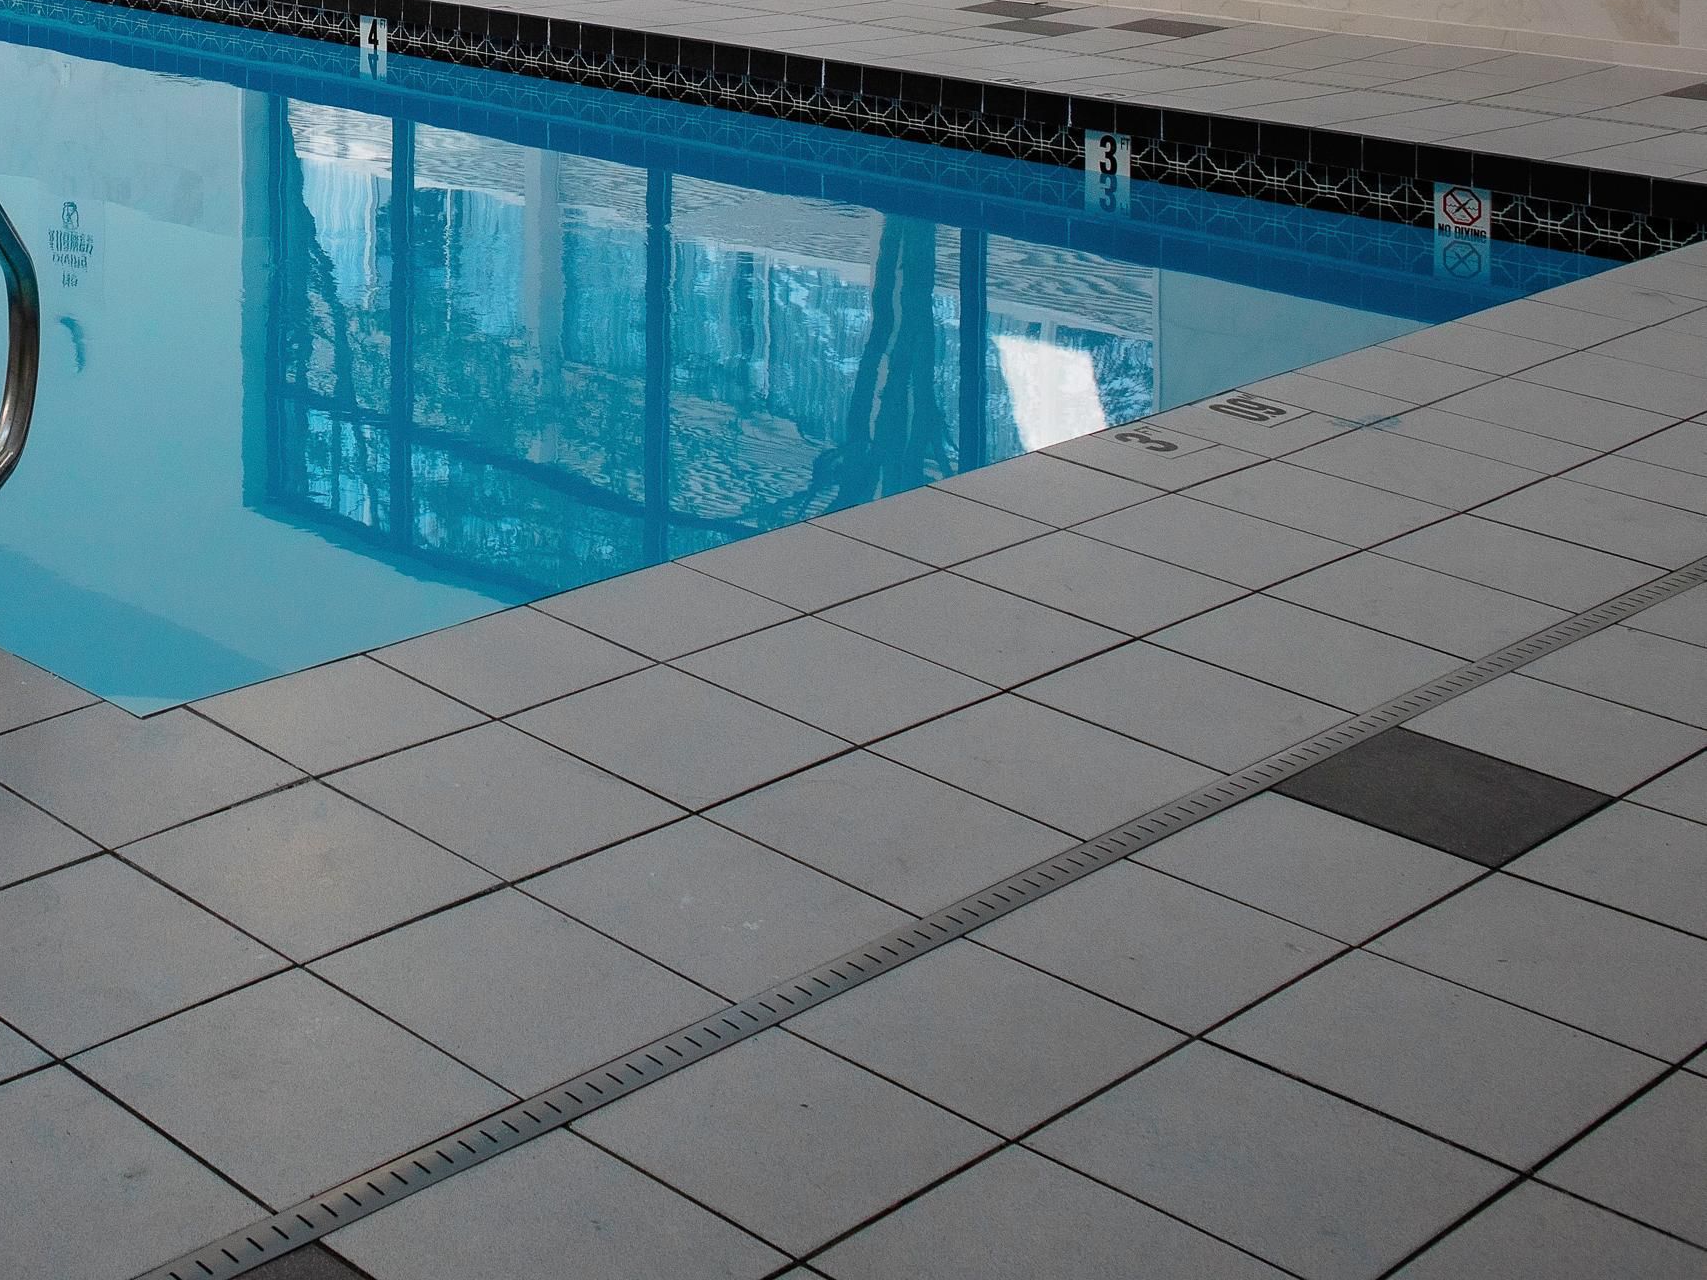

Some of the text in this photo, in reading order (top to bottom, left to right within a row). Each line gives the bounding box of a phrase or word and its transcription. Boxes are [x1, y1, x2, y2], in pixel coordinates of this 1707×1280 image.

[368, 19, 379, 49] 4
[1100, 135, 1131, 175] 3 FT
[1114, 432, 1179, 452] 3
